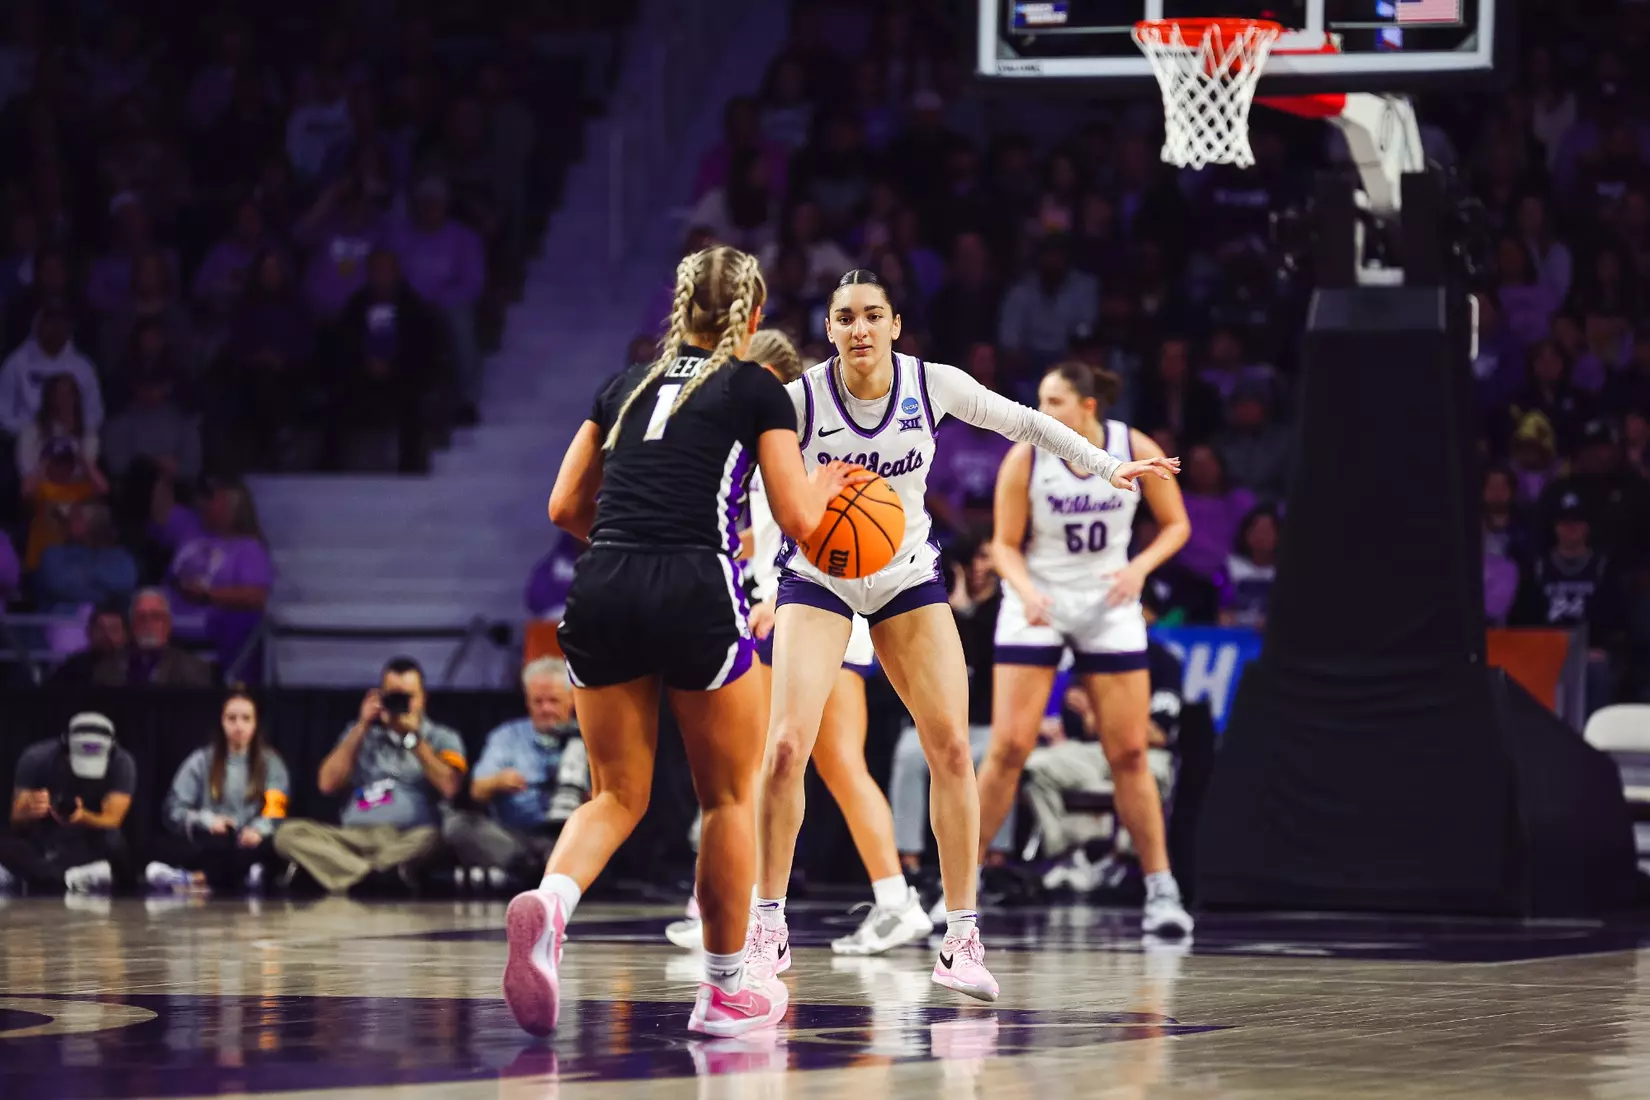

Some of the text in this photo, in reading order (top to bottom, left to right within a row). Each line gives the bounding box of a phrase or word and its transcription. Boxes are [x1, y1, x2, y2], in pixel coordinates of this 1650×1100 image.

[643, 384, 681, 441] 1
[817, 447, 924, 479] ldcats
[1064, 521, 1107, 554] 50
